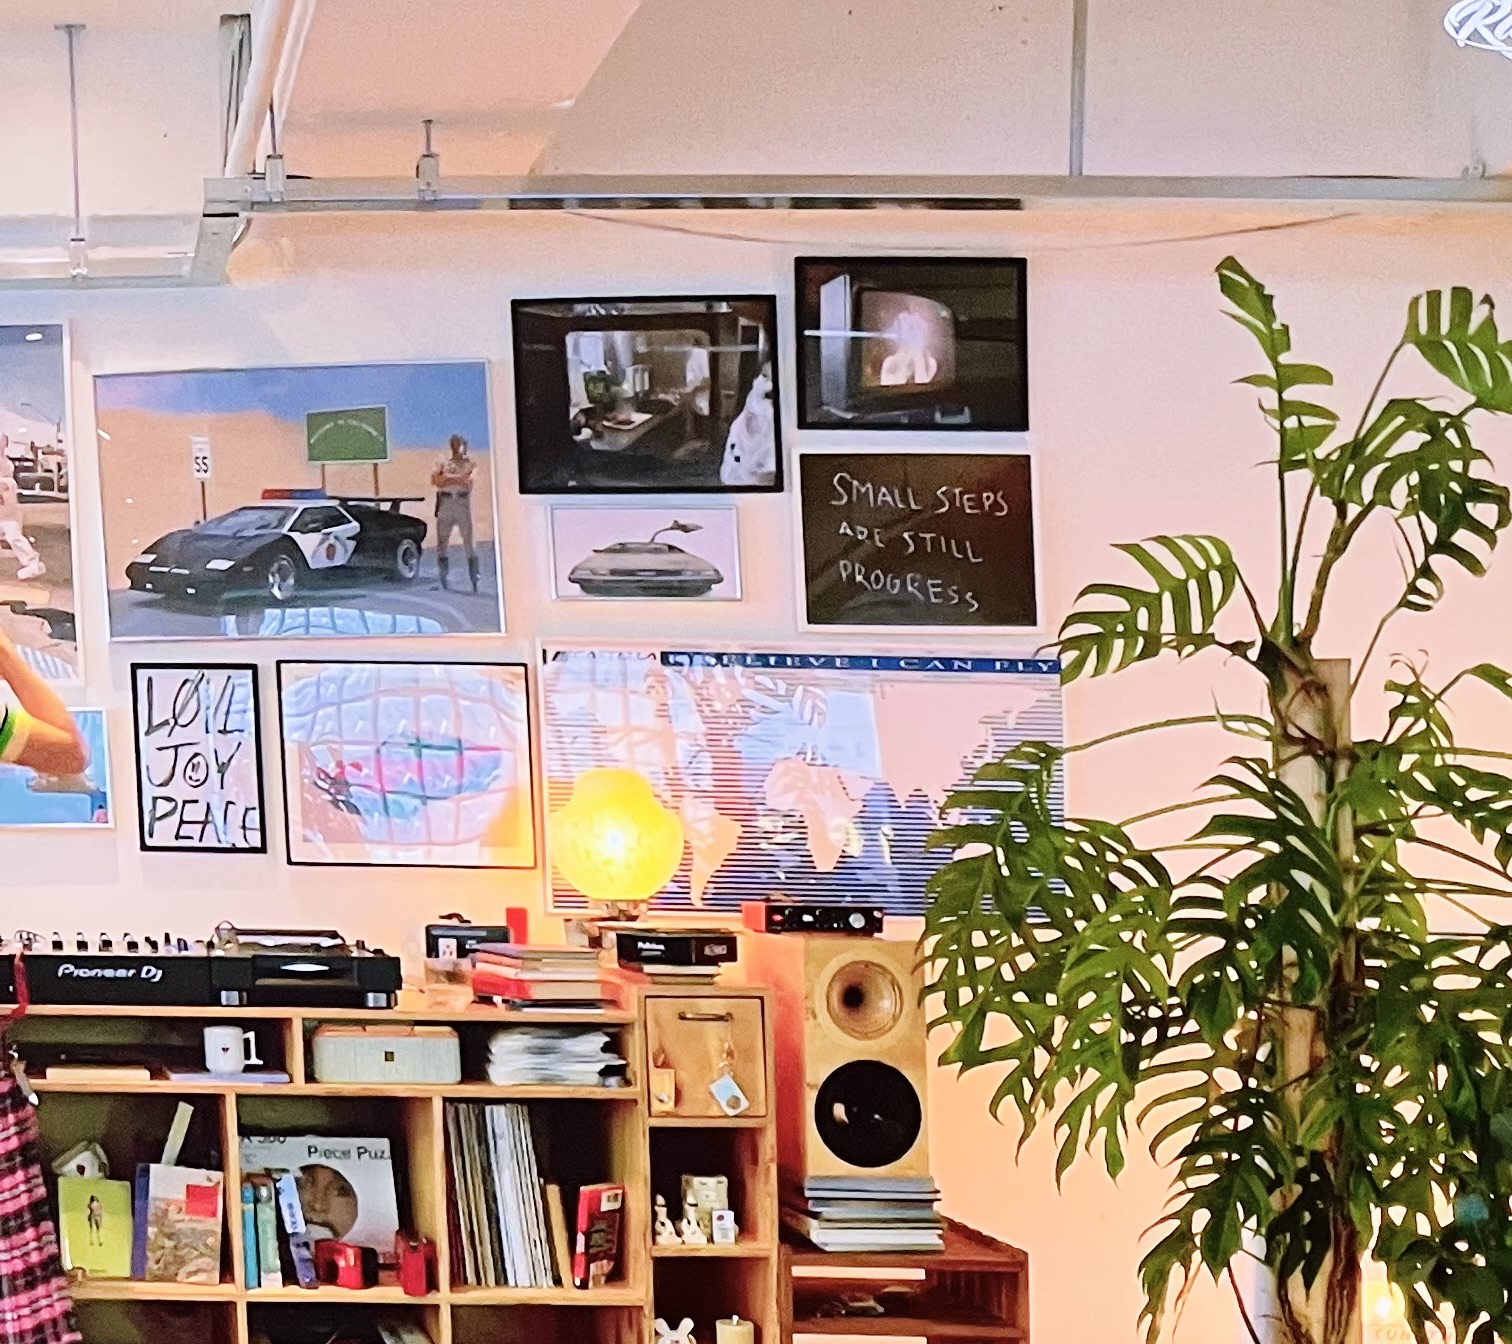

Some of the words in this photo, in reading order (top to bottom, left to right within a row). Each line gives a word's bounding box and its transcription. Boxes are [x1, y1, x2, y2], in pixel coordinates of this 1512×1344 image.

[829, 472, 923, 510] SMALL
[934, 486, 1009, 516] STEPS
[838, 521, 886, 548] ARE
[902, 531, 983, 563] STILL
[839, 559, 980, 613] PROGRESS
[899, 658, 972, 671] CAN
[994, 660, 1054, 673] FLY
[146, 741, 243, 790] JOY
[148, 796, 261, 849] PEACE
[57, 963, 137, 978] Pioneer
